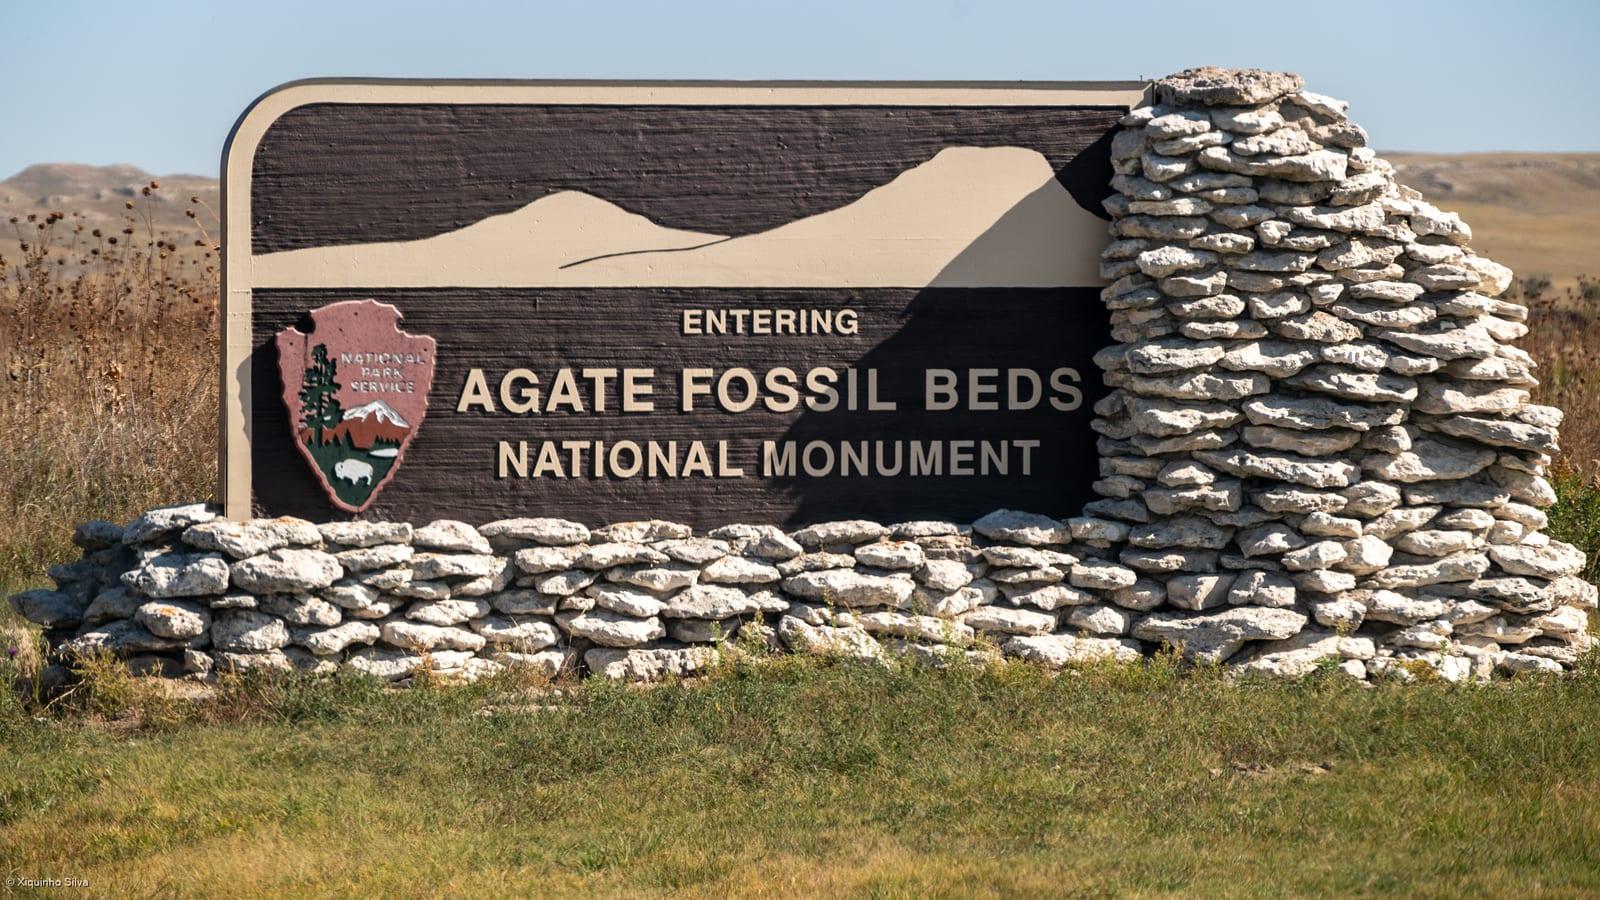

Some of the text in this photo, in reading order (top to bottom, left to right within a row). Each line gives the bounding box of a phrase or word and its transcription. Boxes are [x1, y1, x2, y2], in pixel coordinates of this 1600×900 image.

[682, 308, 859, 335] ENTERING
[341, 352, 426, 365] NATIONAL
[361, 367, 404, 379] PARK
[351, 381, 415, 394] SERVICE
[457, 367, 1083, 414] AGATE FOSSIL BEDS
[498, 440, 1041, 478] NATIONAL MONUMENT
